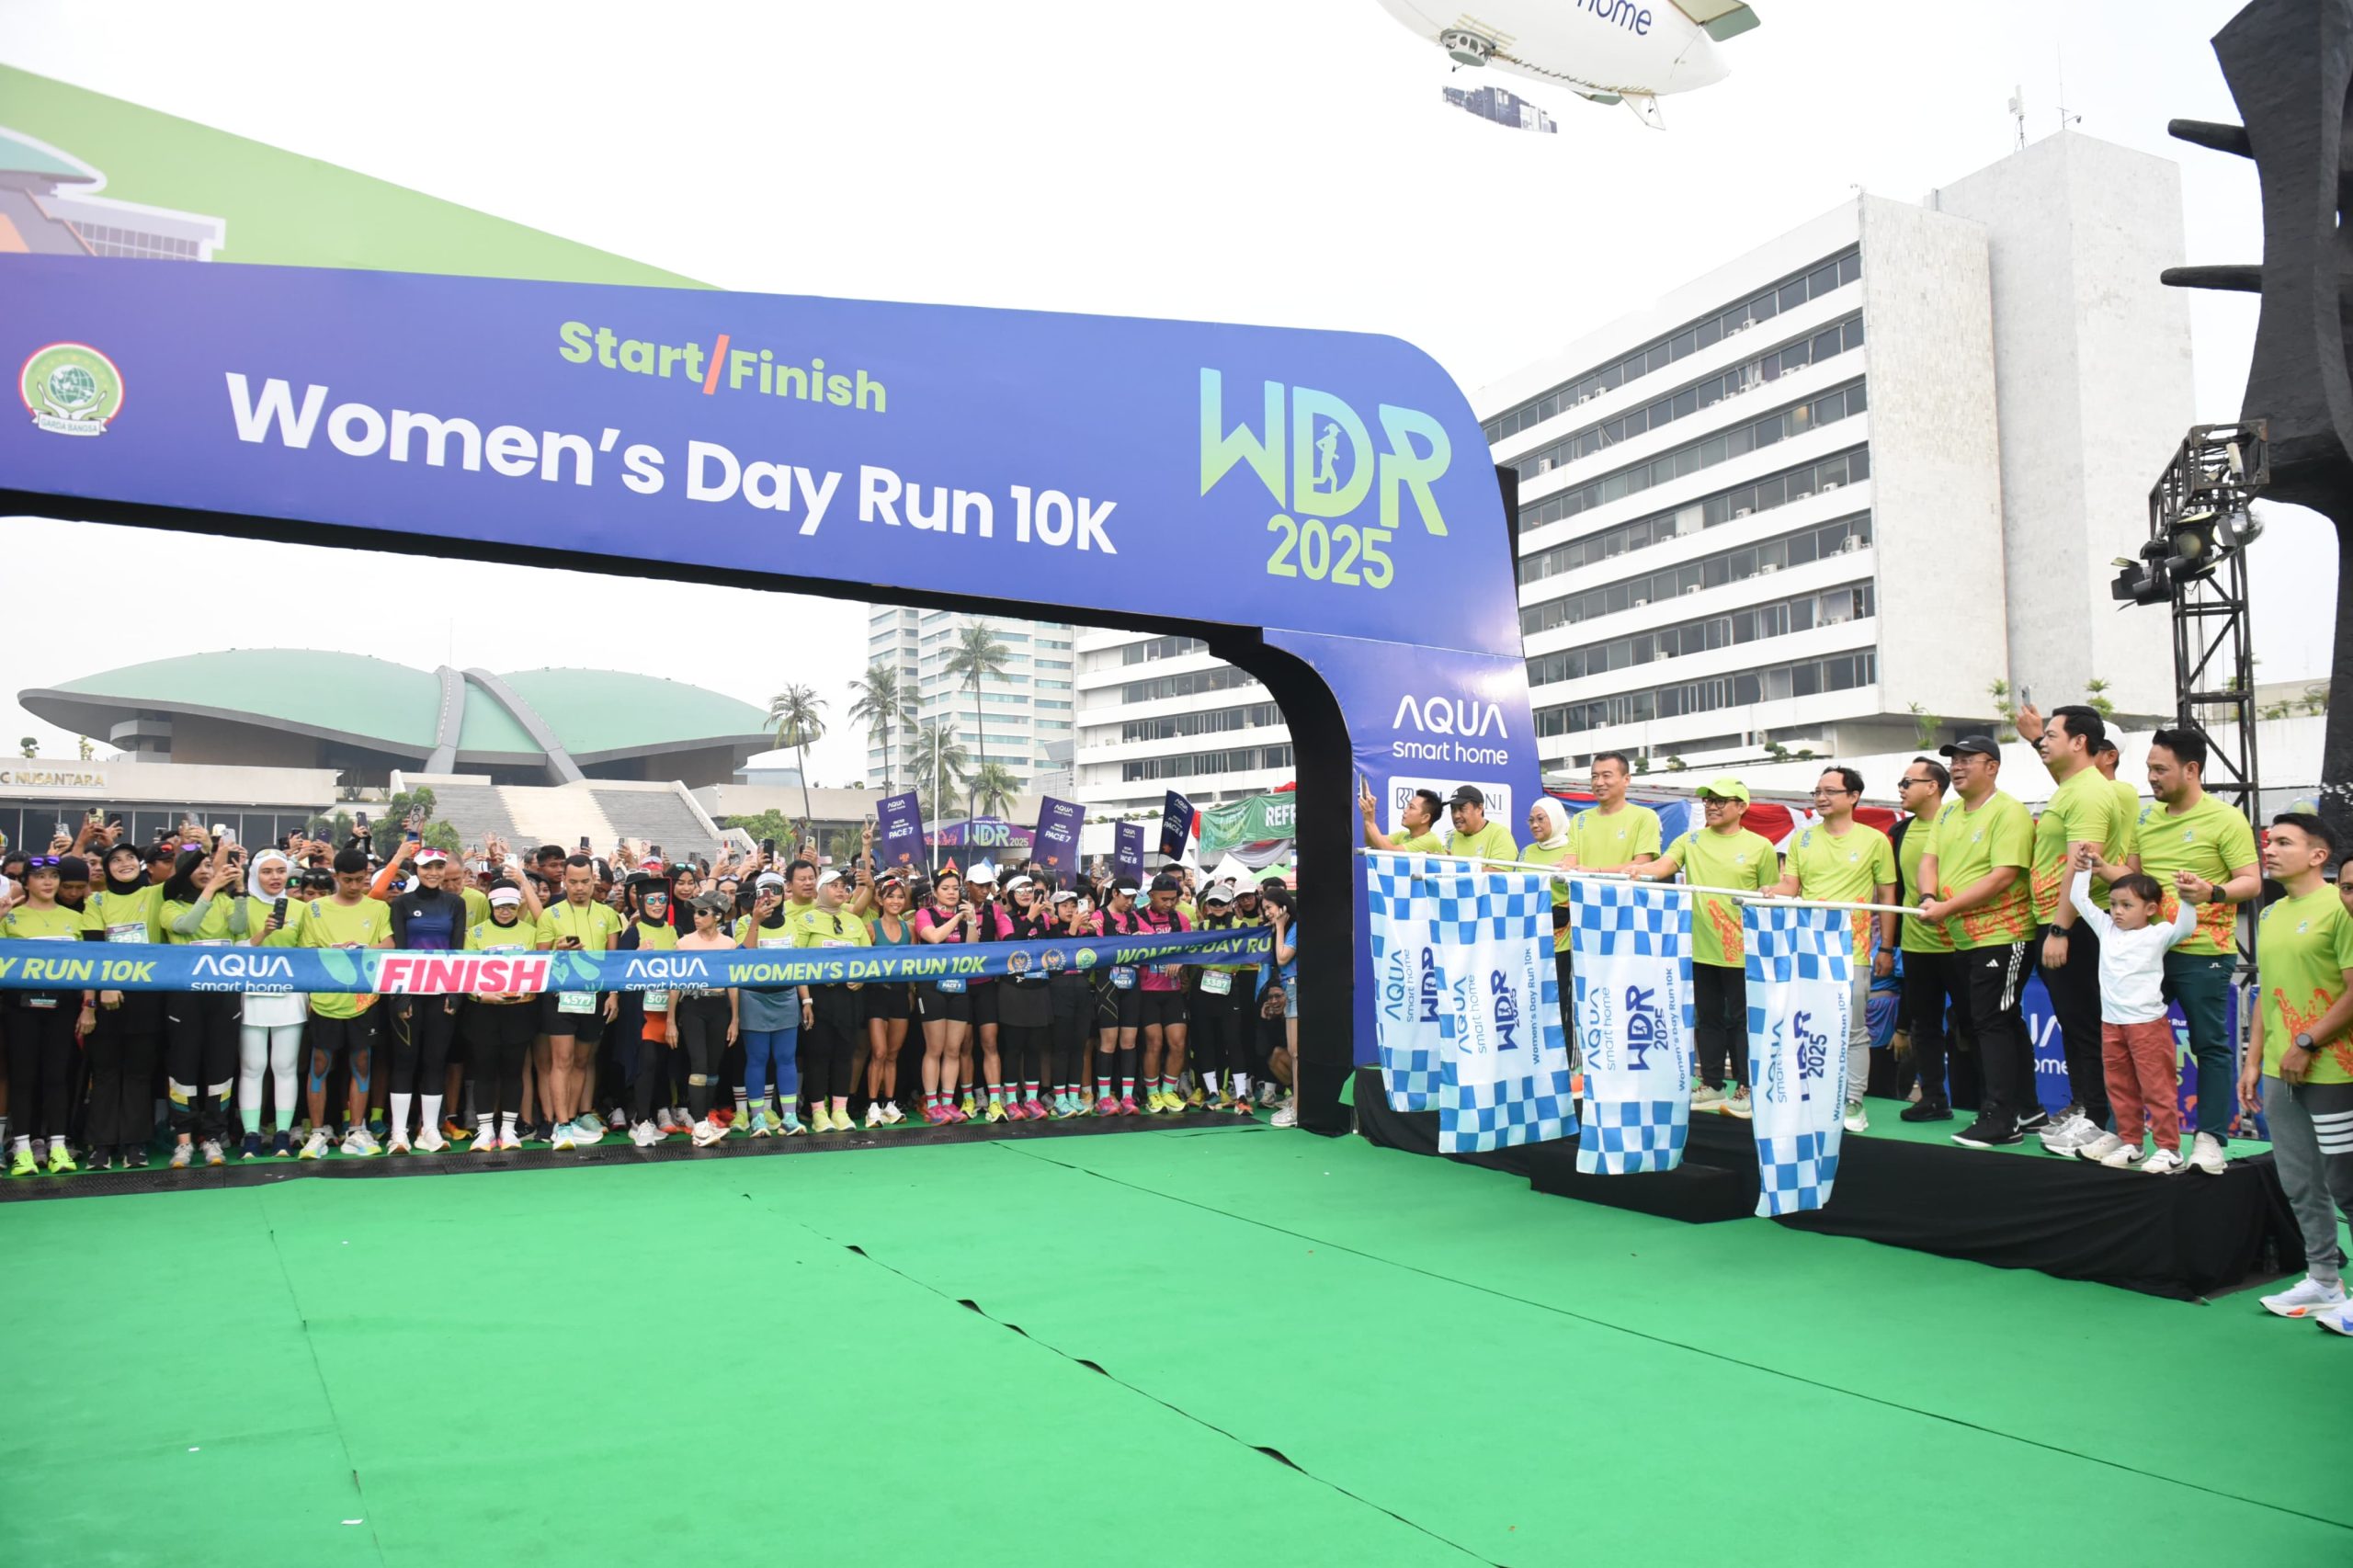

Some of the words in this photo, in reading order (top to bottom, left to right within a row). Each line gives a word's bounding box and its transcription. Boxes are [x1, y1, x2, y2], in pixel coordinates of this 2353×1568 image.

[1577, 0, 1652, 36] ome
[559, 320, 886, 413] Start/Finish
[225, 371, 665, 494] Women's
[686, 439, 843, 536] Day
[858, 464, 994, 539] Run
[1011, 483, 1119, 555] 10K
[1200, 367, 1452, 537] WDR
[1267, 514, 1394, 589] 2025
[1392, 695, 1508, 739] AQUA
[1392, 741, 1449, 761] smart
[1455, 741, 1508, 765] home
[15, 772, 105, 787] NUSANTARA
[887, 799, 905, 809] AQUA
[1053, 804, 1074, 814] AQUA
[889, 828, 907, 839] PACE
[908, 826, 914, 835] 7
[964, 824, 1011, 846] WDR
[1010, 837, 1029, 846] 2025
[1045, 830, 1064, 842] PACE
[21, 958, 95, 981] RUN
[101, 960, 157, 982] 10K
[191, 954, 294, 977] AQUA
[625, 958, 709, 979] AQUA
[729, 961, 844, 983] WOMEN'S
[848, 960, 896, 979] DAY
[901, 958, 948, 975] RUN
[951, 956, 988, 973] 10K
[1404, 949, 1414, 983] home
[1524, 948, 1532, 965] 10K
[191, 981, 243, 992] smart
[245, 981, 294, 992] home
[379, 959, 547, 993] FINISH
[625, 981, 667, 992] smart
[1384, 949, 1404, 1021] AQUA
[1420, 947, 1440, 1022] WDR
[1527, 967, 1535, 988] Run
[1665, 968, 1674, 986] 10K
[563, 996, 592, 1006] 4577
[1469, 974, 1479, 1013] home
[1529, 990, 1538, 1011] Day
[1602, 987, 1612, 1027] home
[1453, 976, 1472, 1054] AQUA
[1490, 969, 1518, 1051] WDR
[1472, 1015, 1486, 1053] smart
[1588, 987, 1601, 1070] AQUA
[1625, 984, 1654, 1071] WDR
[1669, 1013, 1679, 1035] Day
[1529, 1013, 1540, 1064] Women's
[1604, 1029, 1615, 1071] smart
[1838, 1040, 1847, 1063] Day
[1673, 1038, 1685, 1092] Women's
[1806, 1033, 1827, 1078] 2025
[2034, 1059, 2069, 1074] ome
